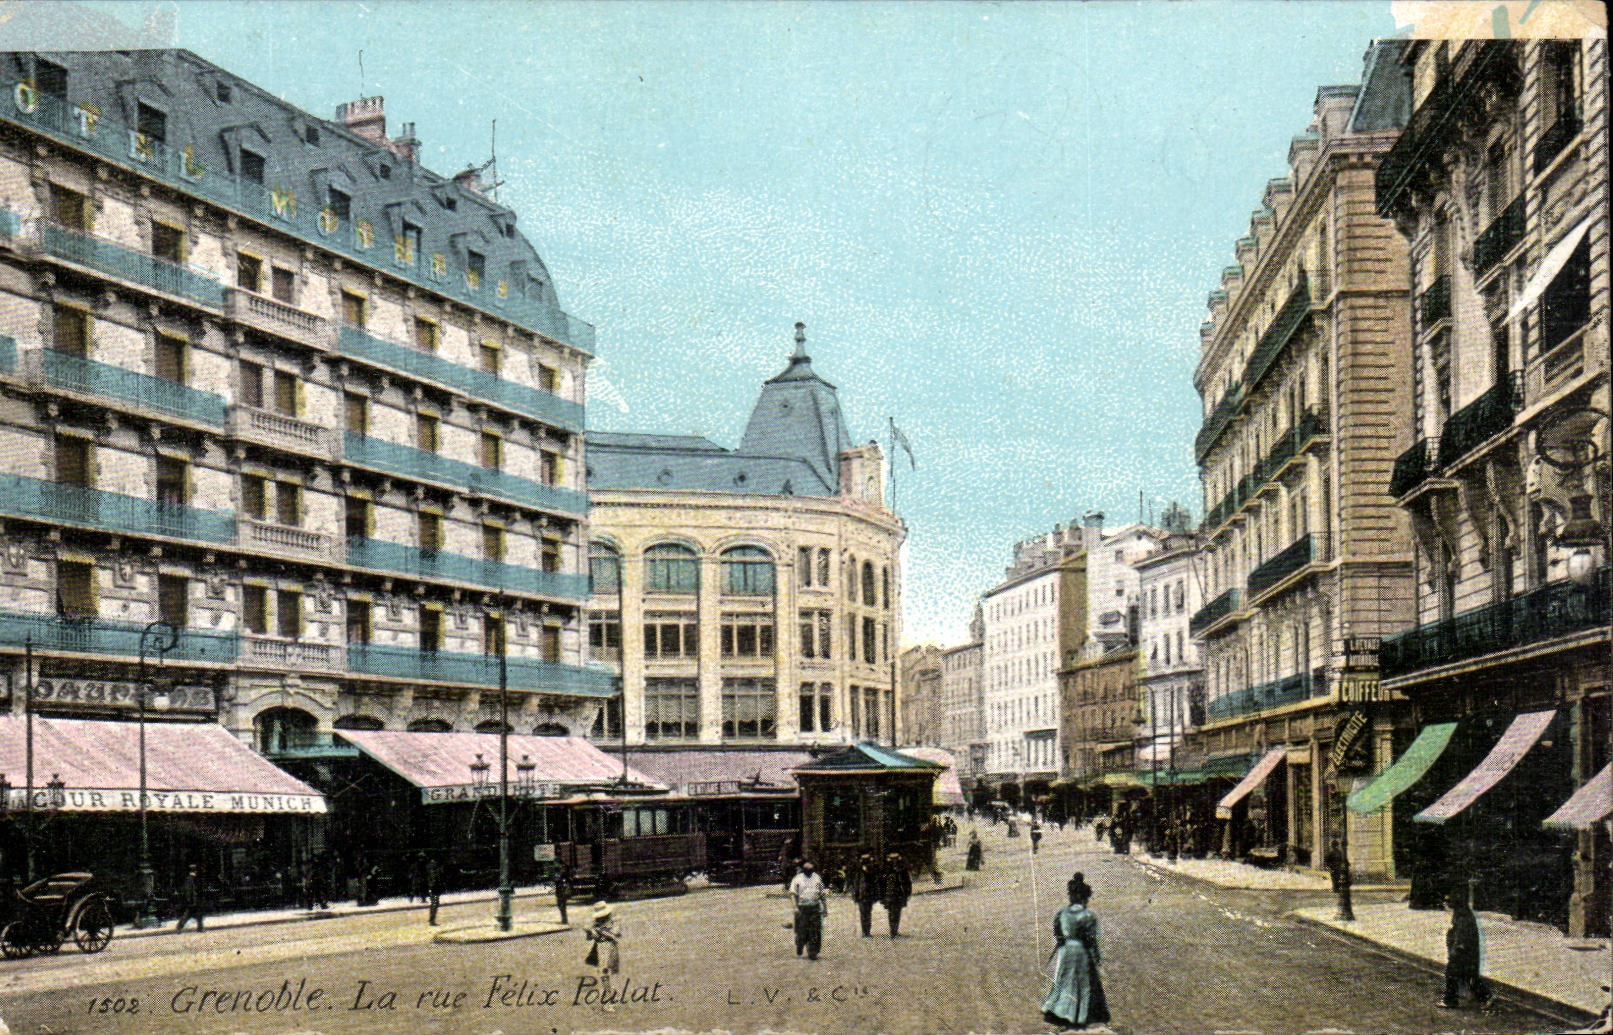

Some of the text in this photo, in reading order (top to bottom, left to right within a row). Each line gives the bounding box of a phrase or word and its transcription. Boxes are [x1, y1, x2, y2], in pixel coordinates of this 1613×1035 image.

[32, 790, 106, 808] COUR
[120, 792, 214, 809] ROYALE
[231, 795, 312, 811] MUNICH
[430, 783, 561, 800] GRAND HOTE
